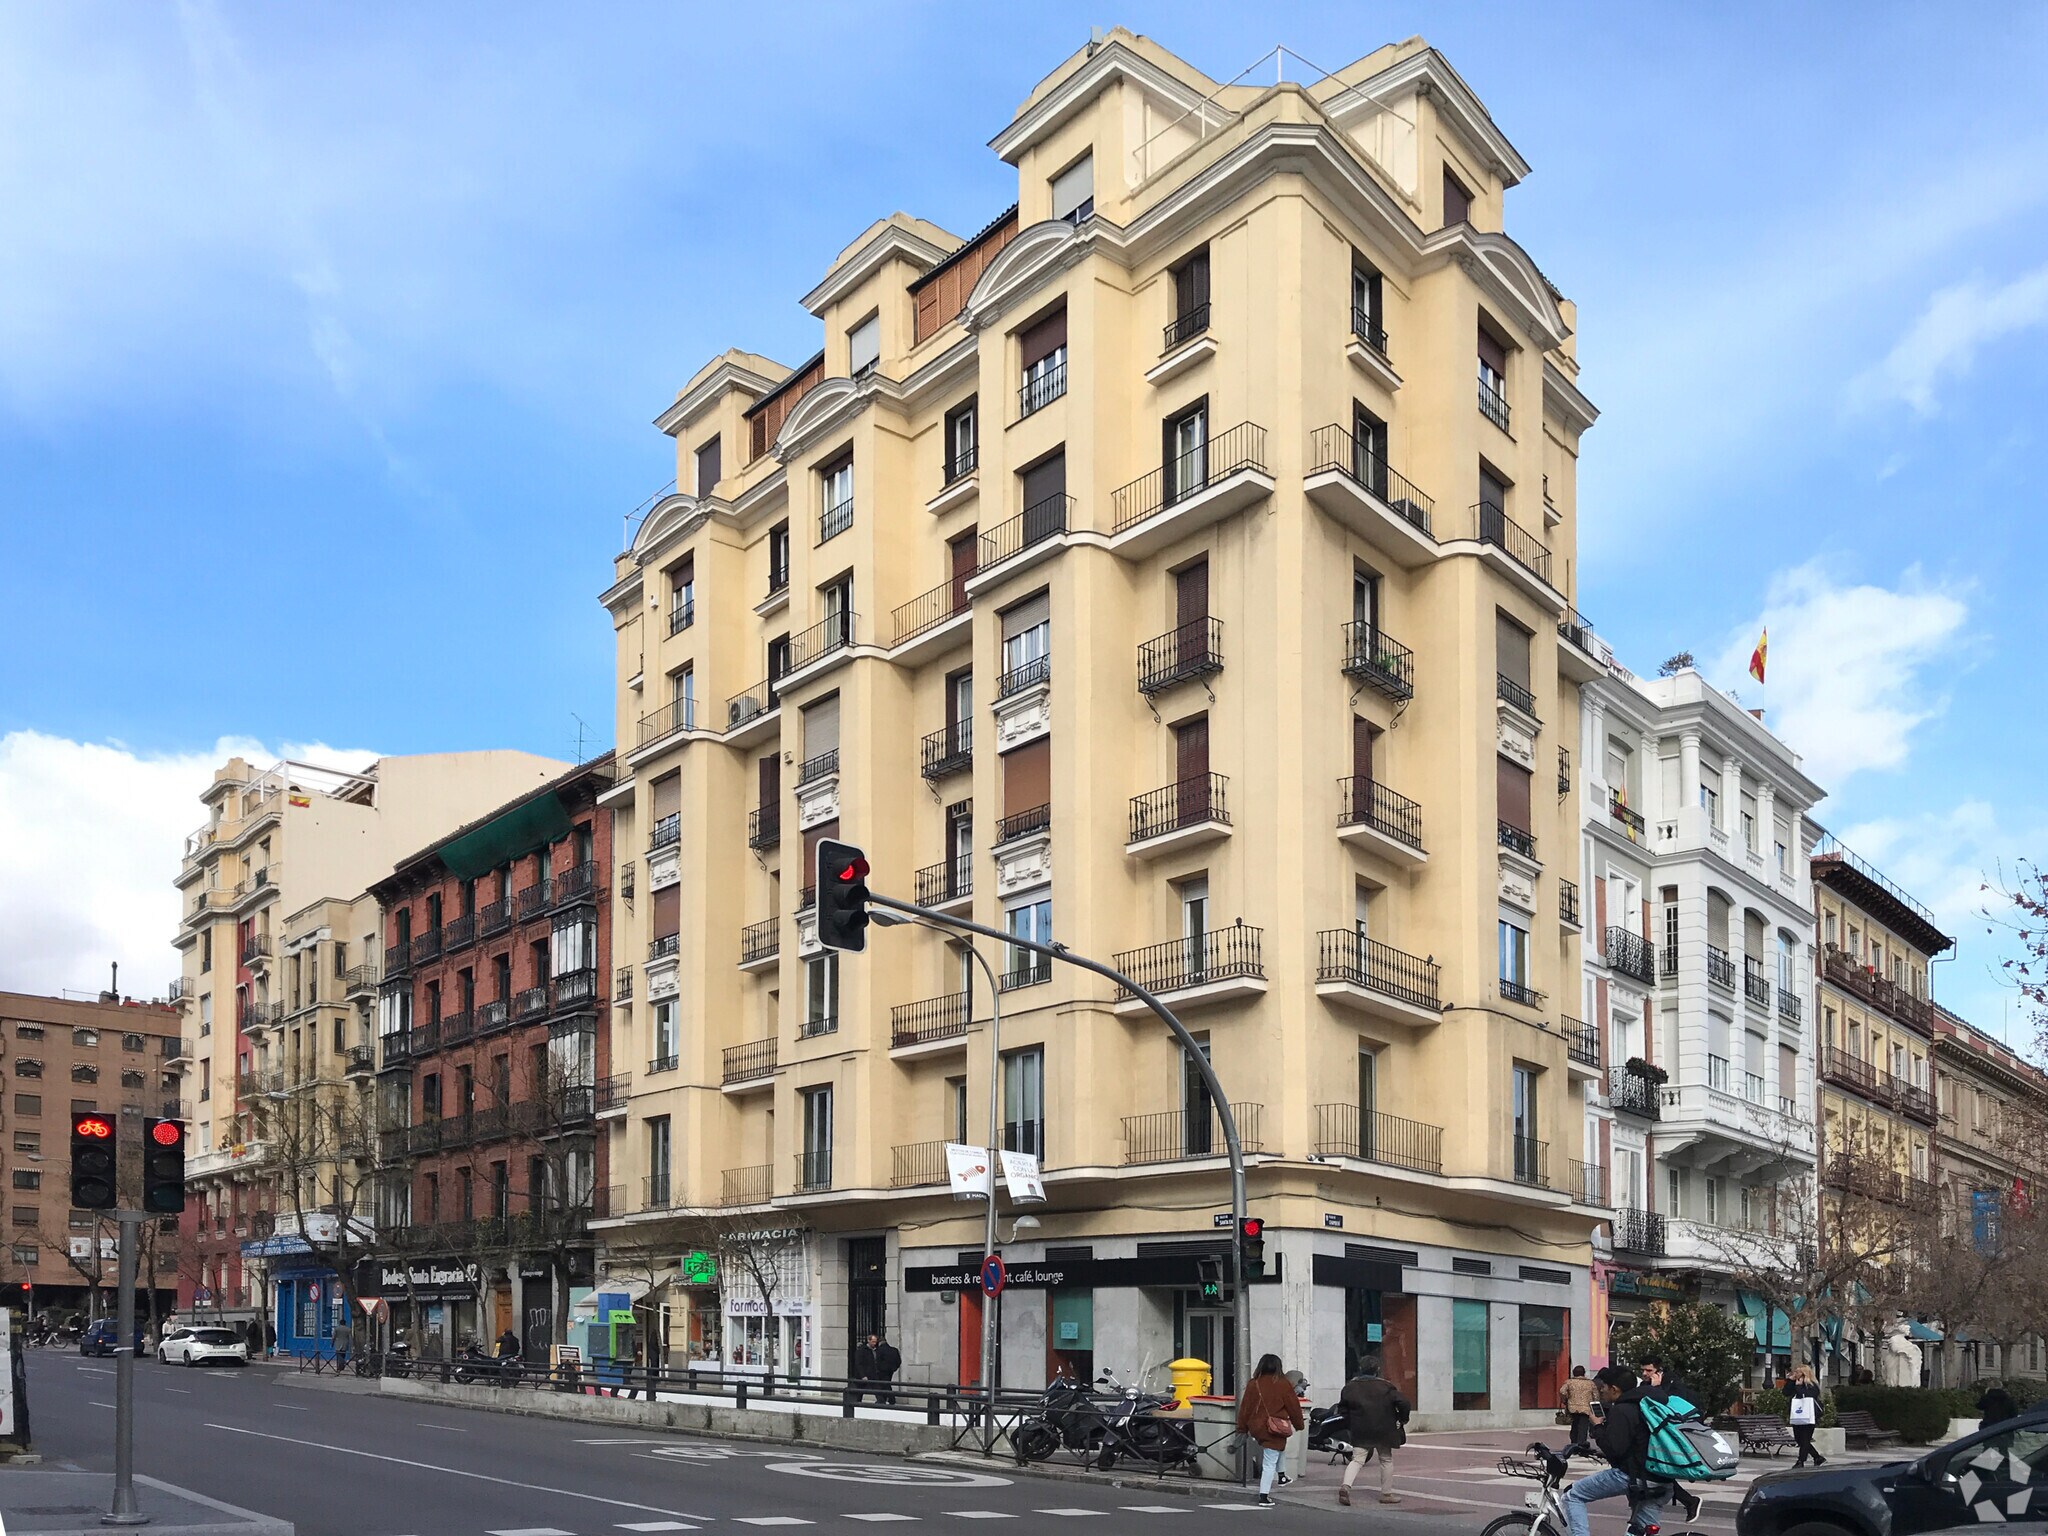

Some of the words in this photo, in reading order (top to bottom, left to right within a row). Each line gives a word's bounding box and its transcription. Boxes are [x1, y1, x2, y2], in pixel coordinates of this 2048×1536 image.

[720, 1229, 799, 1241] FARMACIA
[409, 1266, 430, 1284] Santa
[430, 1265, 465, 1286] Engracia
[465, 1263, 478, 1282] 42
[931, 1273, 962, 1285] business
[964, 1273, 971, 1284] &
[1015, 1270, 1034, 1283] café,
[1035, 1269, 1064, 1284] lounge
[730, 1299, 767, 1313] farmaci
